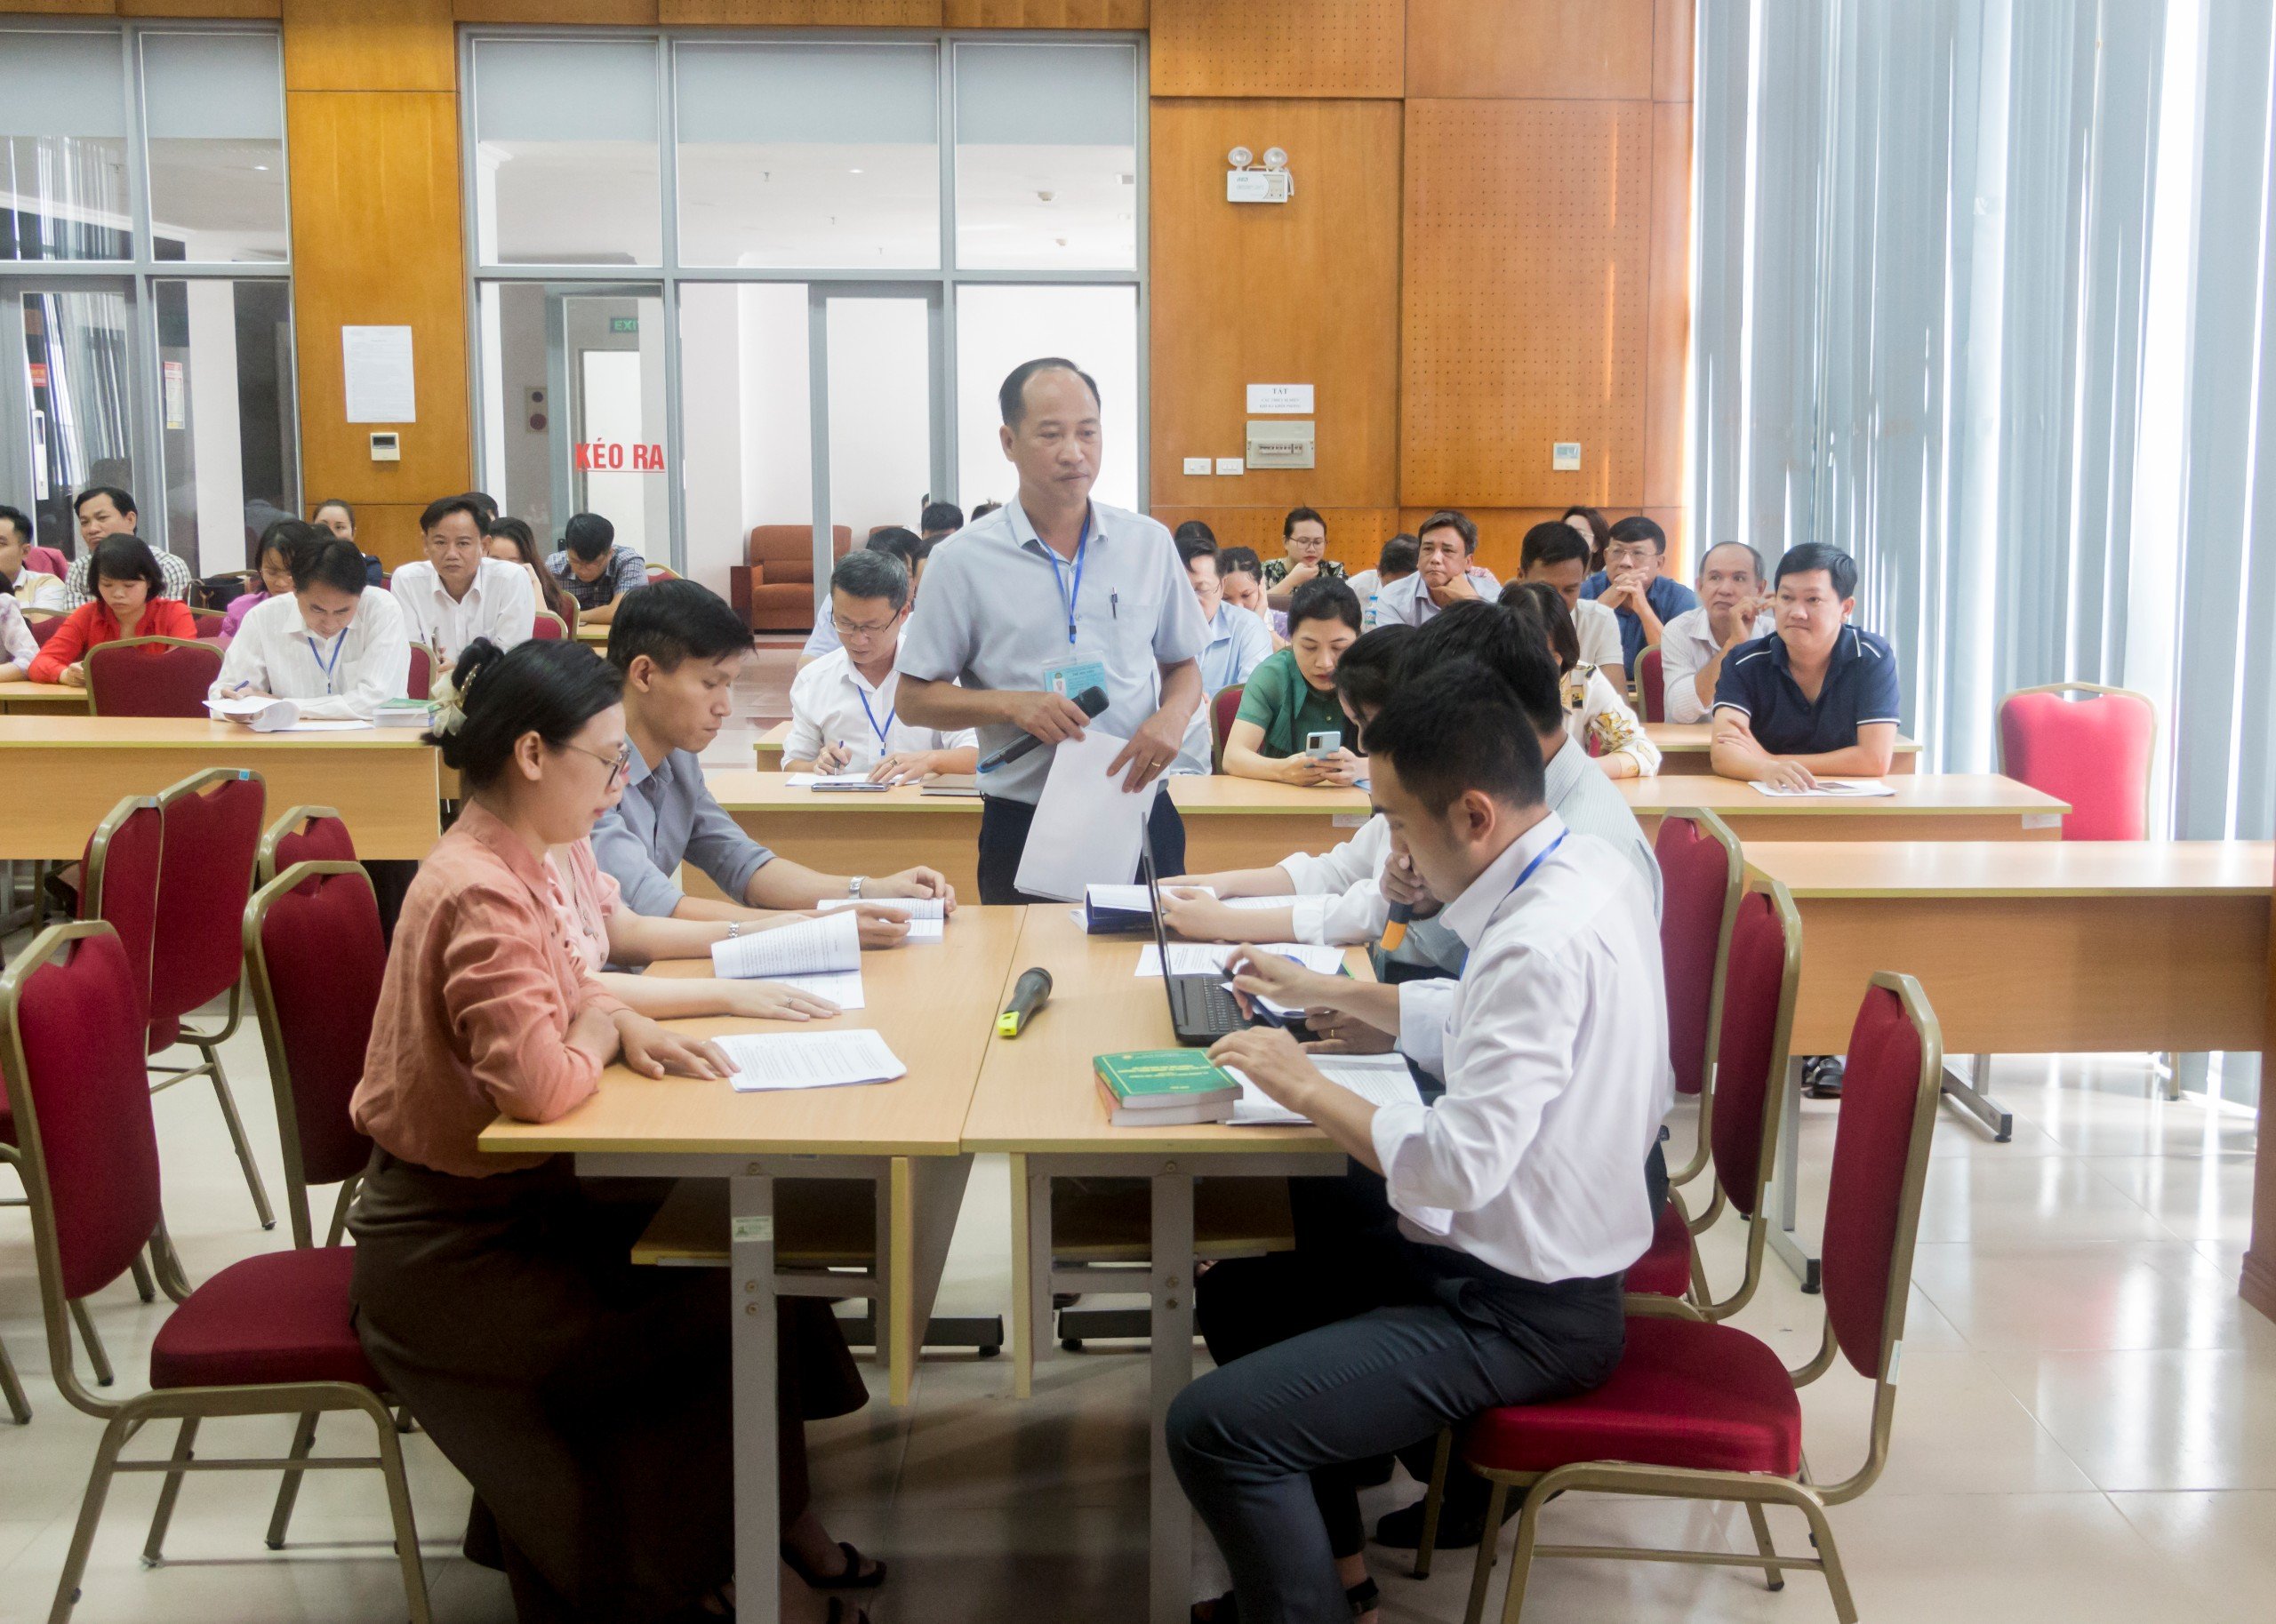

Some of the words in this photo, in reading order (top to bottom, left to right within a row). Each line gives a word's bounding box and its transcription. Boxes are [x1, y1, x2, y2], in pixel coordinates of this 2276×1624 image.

[613, 319, 637, 331] EXI
[575, 437, 623, 469] KÉO
[633, 444, 665, 470] RA
